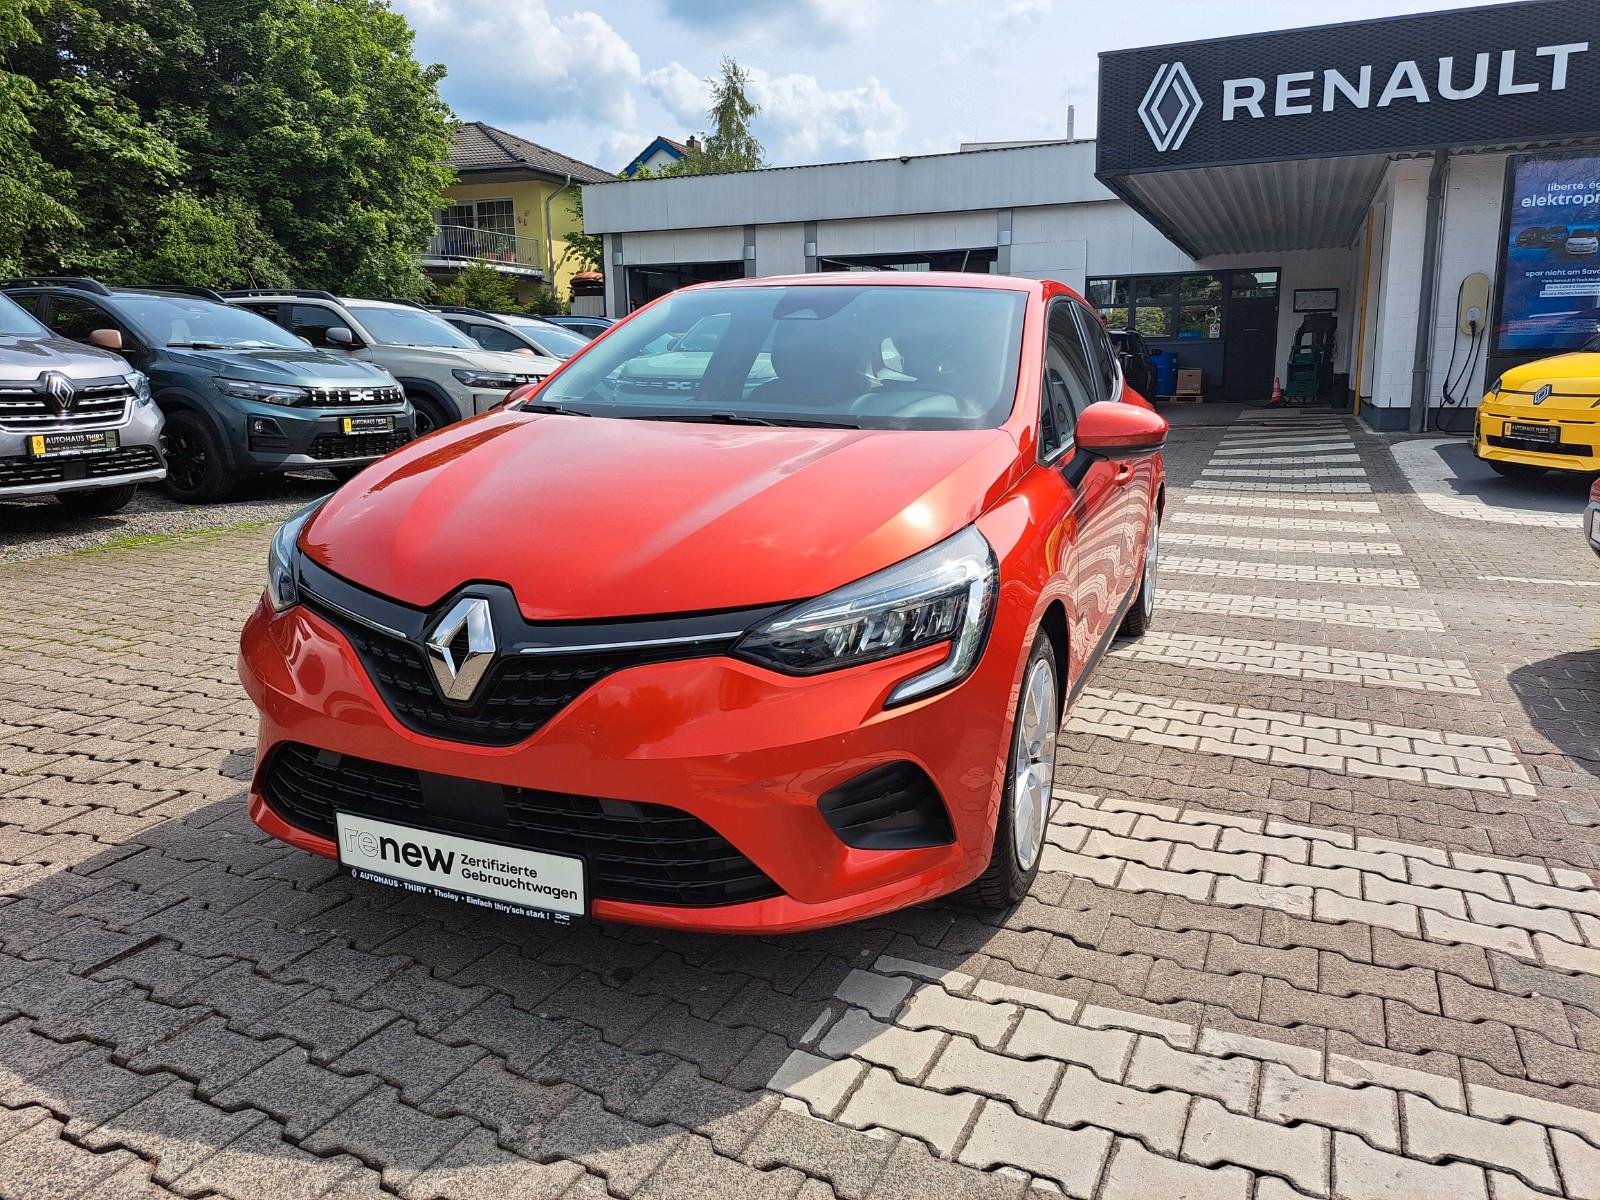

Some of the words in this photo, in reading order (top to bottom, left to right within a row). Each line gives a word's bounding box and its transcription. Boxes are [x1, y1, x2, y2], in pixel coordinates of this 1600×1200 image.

[1222, 41, 1589, 121] RENAULT
[45, 434, 85, 444] AUTOHAUS
[343, 827, 455, 875] renew
[460, 853, 538, 878] Zertifizierte
[359, 871, 399, 888] AUTOHAUS
[403, 882, 427, 894] THIRY
[433, 889, 459, 902] Tholey
[466, 895, 493, 909] Einfach
[525, 909, 545, 920] stark
[461, 869, 578, 901] Gebrauchtwagen
